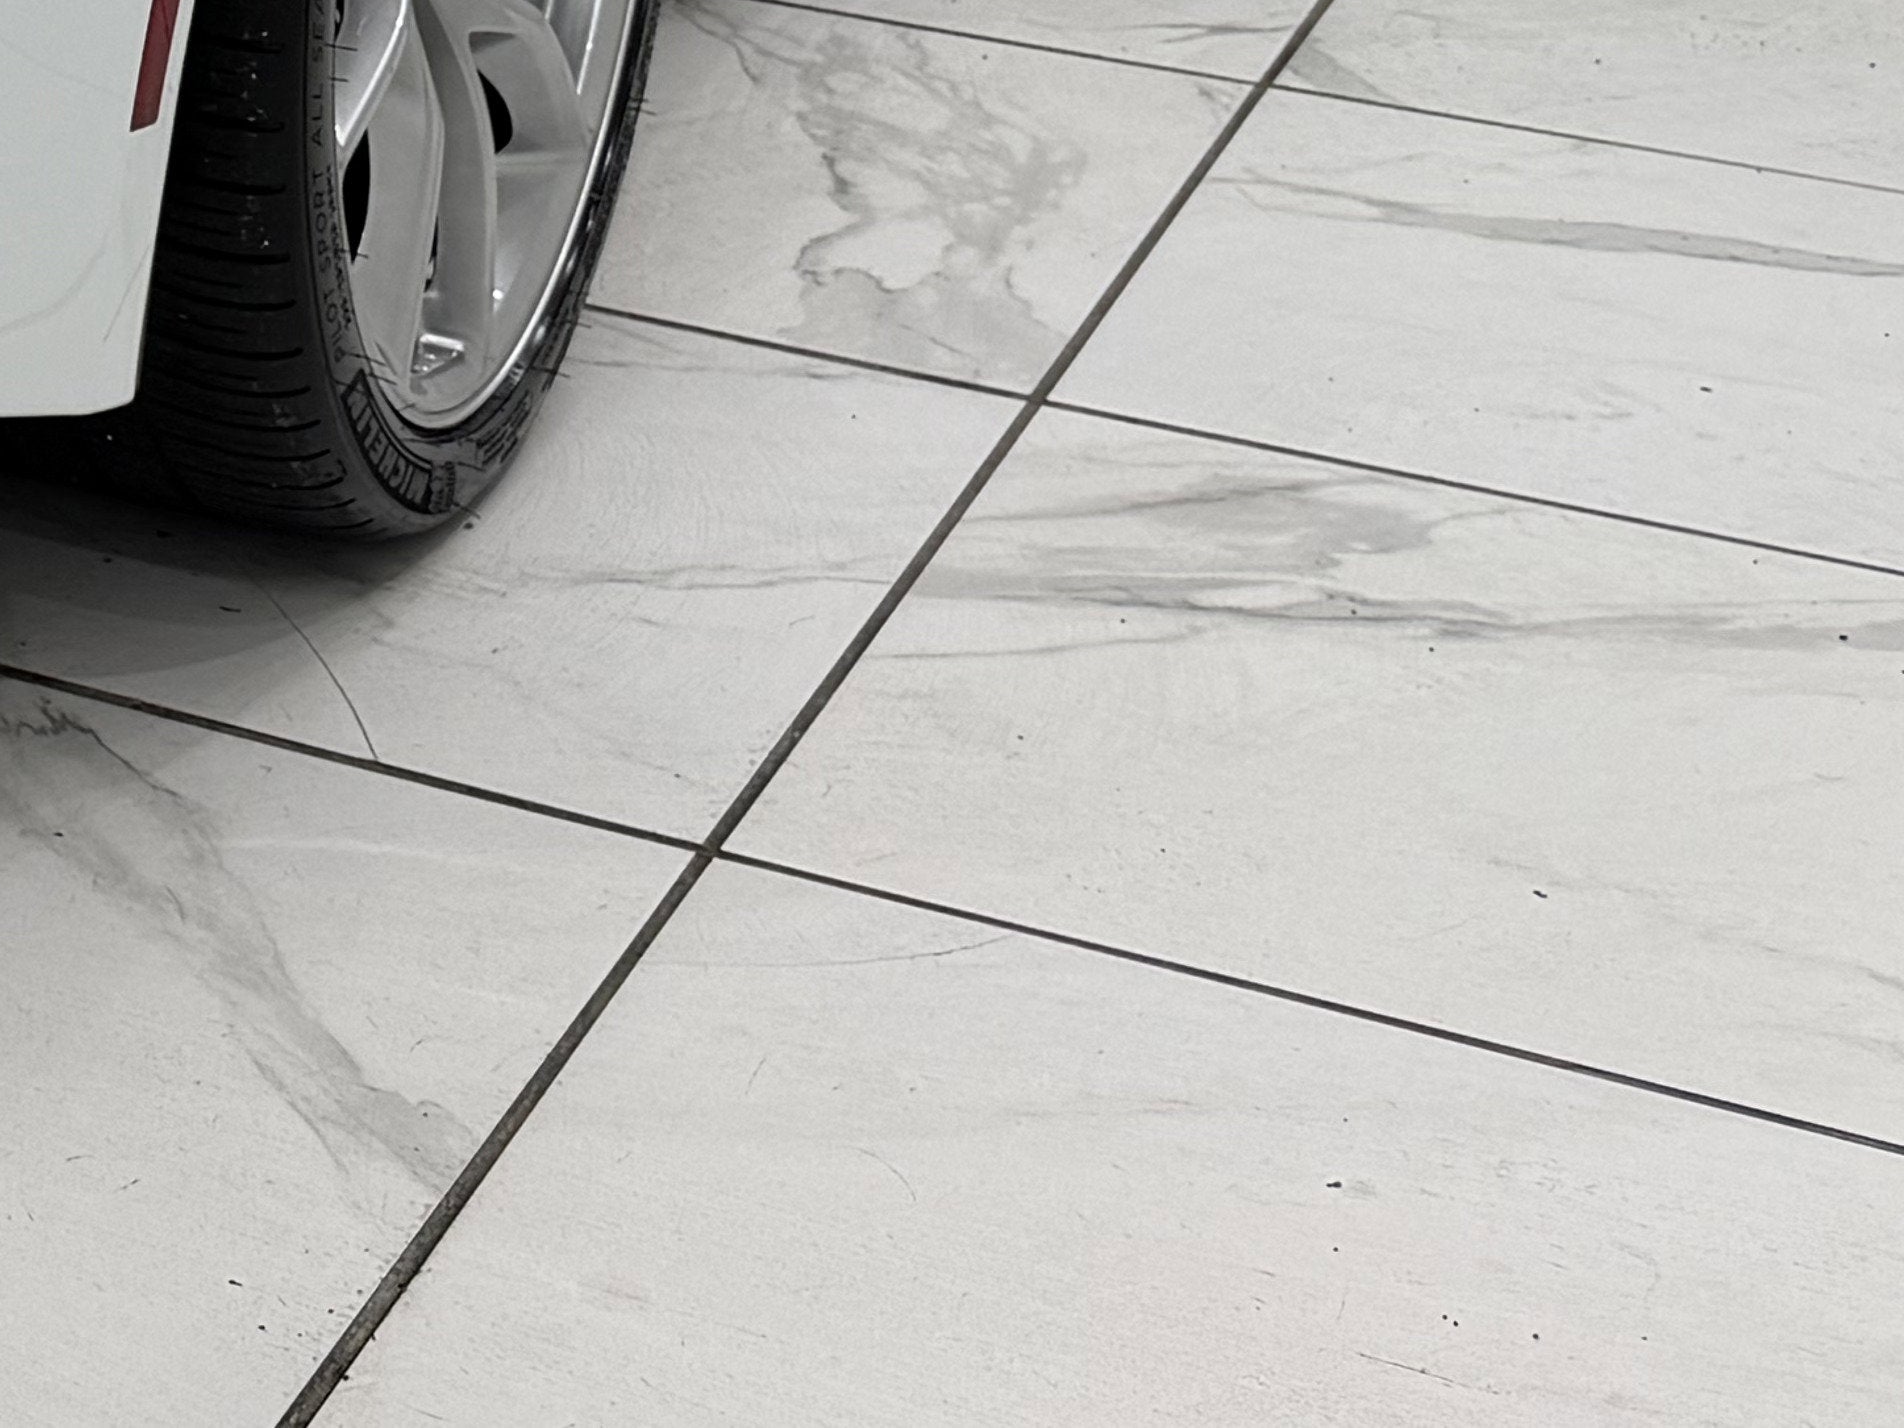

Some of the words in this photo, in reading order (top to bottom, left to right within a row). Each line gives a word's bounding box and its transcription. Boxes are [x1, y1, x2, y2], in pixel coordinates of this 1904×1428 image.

[310, 82, 324, 148] ALL
[311, 170, 332, 274] SPORT
[322, 289, 347, 364] PILOT
[346, 391, 429, 504] MICHELIN
